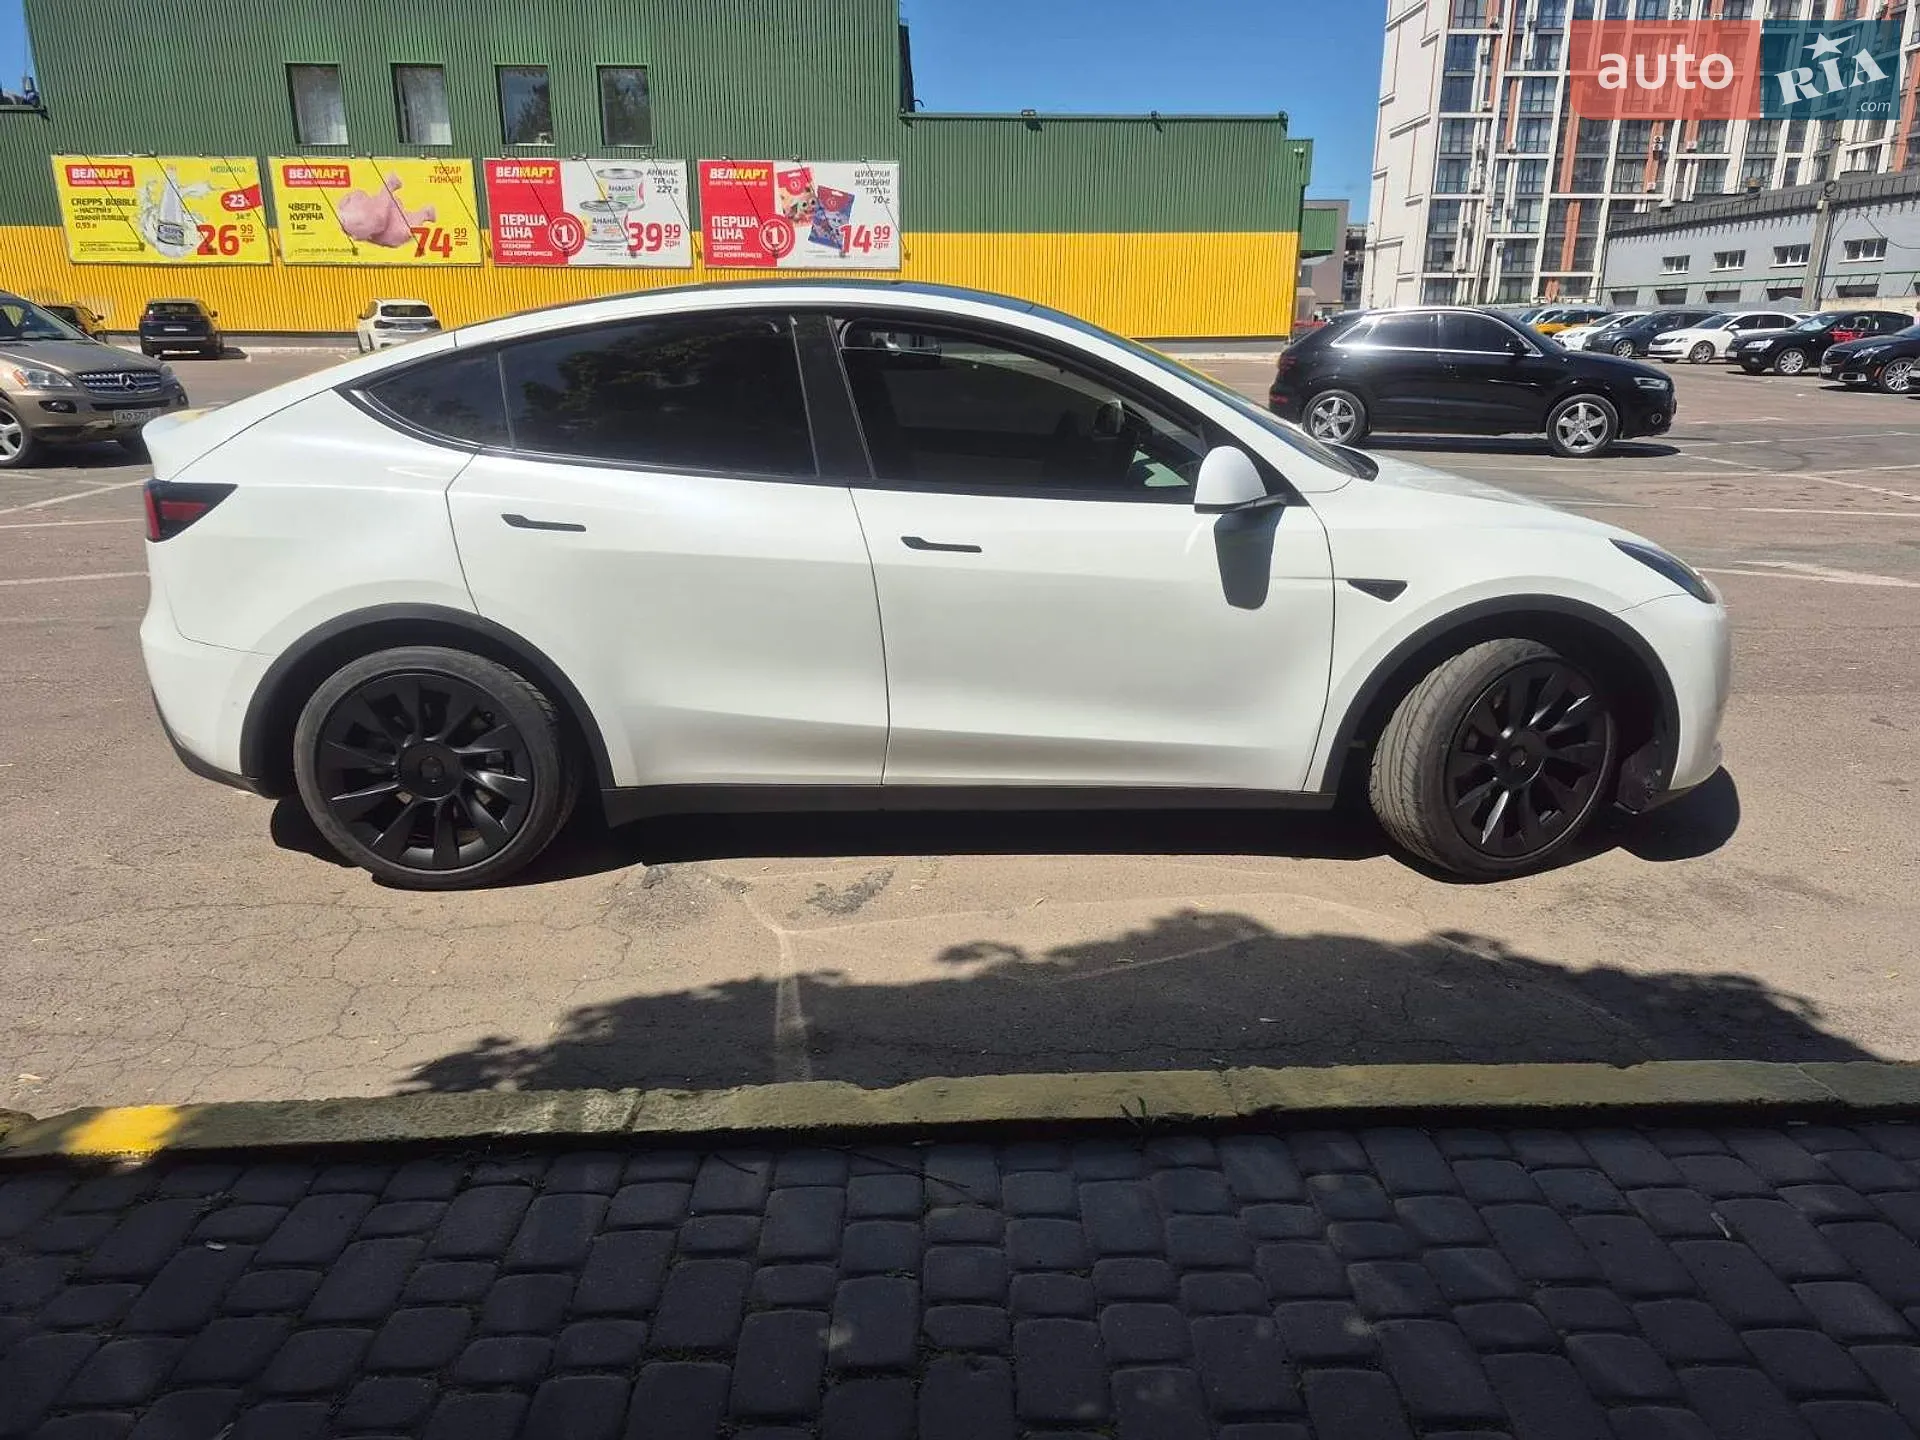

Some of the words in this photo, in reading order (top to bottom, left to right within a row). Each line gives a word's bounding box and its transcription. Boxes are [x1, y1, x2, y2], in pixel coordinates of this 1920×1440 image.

[71, 166, 130, 180] ВЕЛМАРТ
[288, 168, 346, 179] ВЕЛМАРТ
[434, 166, 461, 174] ТОВАР
[495, 166, 555, 178] ВЕЛМАРТ
[709, 168, 769, 179] ВЕЛМАРТ
[854, 170, 890, 178] ЦУКЕРКИ
[71, 198, 103, 206] CREPPS
[288, 203, 322, 211] ЧВЕРТЬ
[289, 212, 324, 220] КУРЯЧА
[500, 214, 548, 226] ПЕРША
[712, 215, 759, 227] ПЕРША
[501, 227, 533, 239] ЦІНА
[627, 222, 662, 252] 39
[665, 224, 681, 238] 99
[712, 227, 744, 241] ЦІНА
[841, 224, 872, 253] 14
[874, 225, 890, 240] 99
[197, 224, 239, 255] 26
[240, 224, 254, 234] 99
[411, 227, 453, 257] 74
[455, 228, 467, 237] 99
